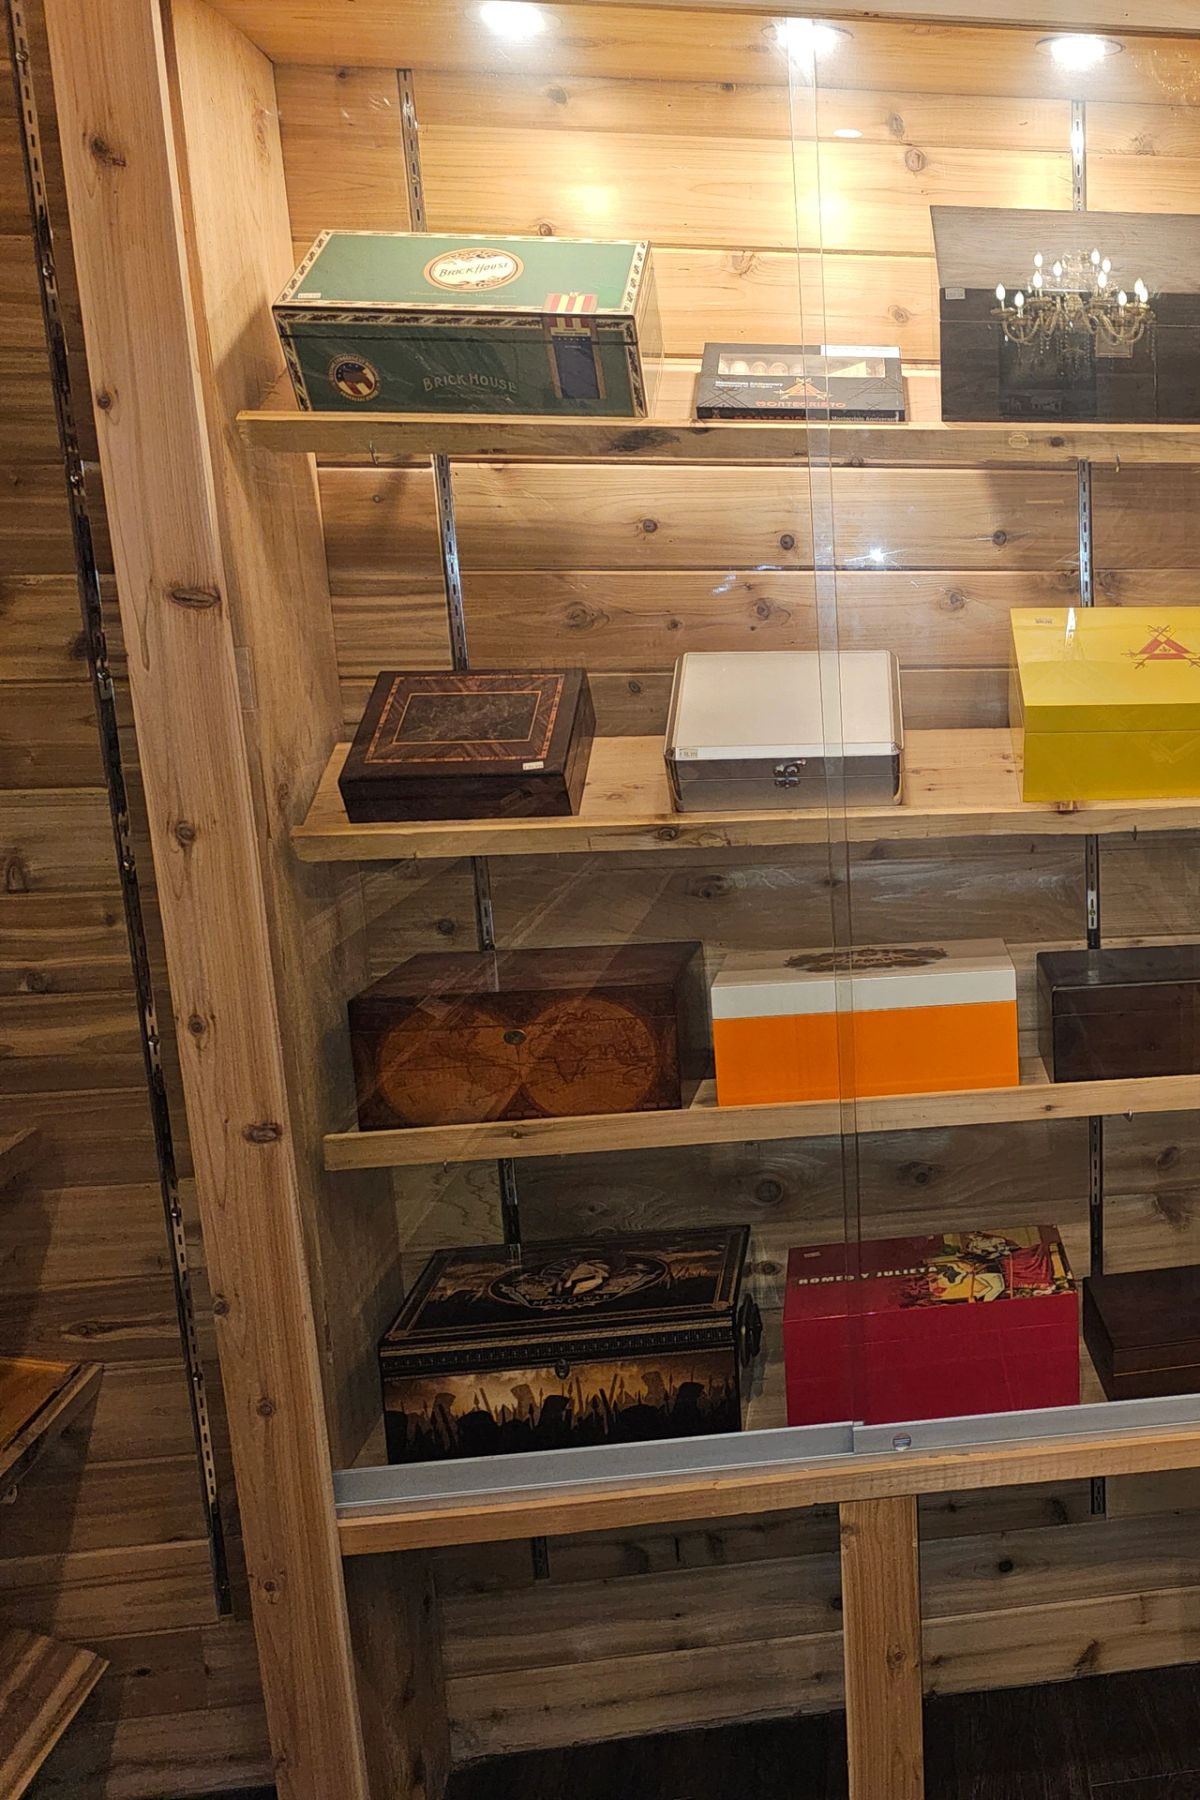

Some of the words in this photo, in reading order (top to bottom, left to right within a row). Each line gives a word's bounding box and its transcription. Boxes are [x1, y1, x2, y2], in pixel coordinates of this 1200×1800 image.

[422, 373, 466, 392] BRICK
[468, 372, 519, 394] HOUSE
[798, 1275, 855, 1285] ROMEO
[876, 1266, 938, 1278] JULIETA
